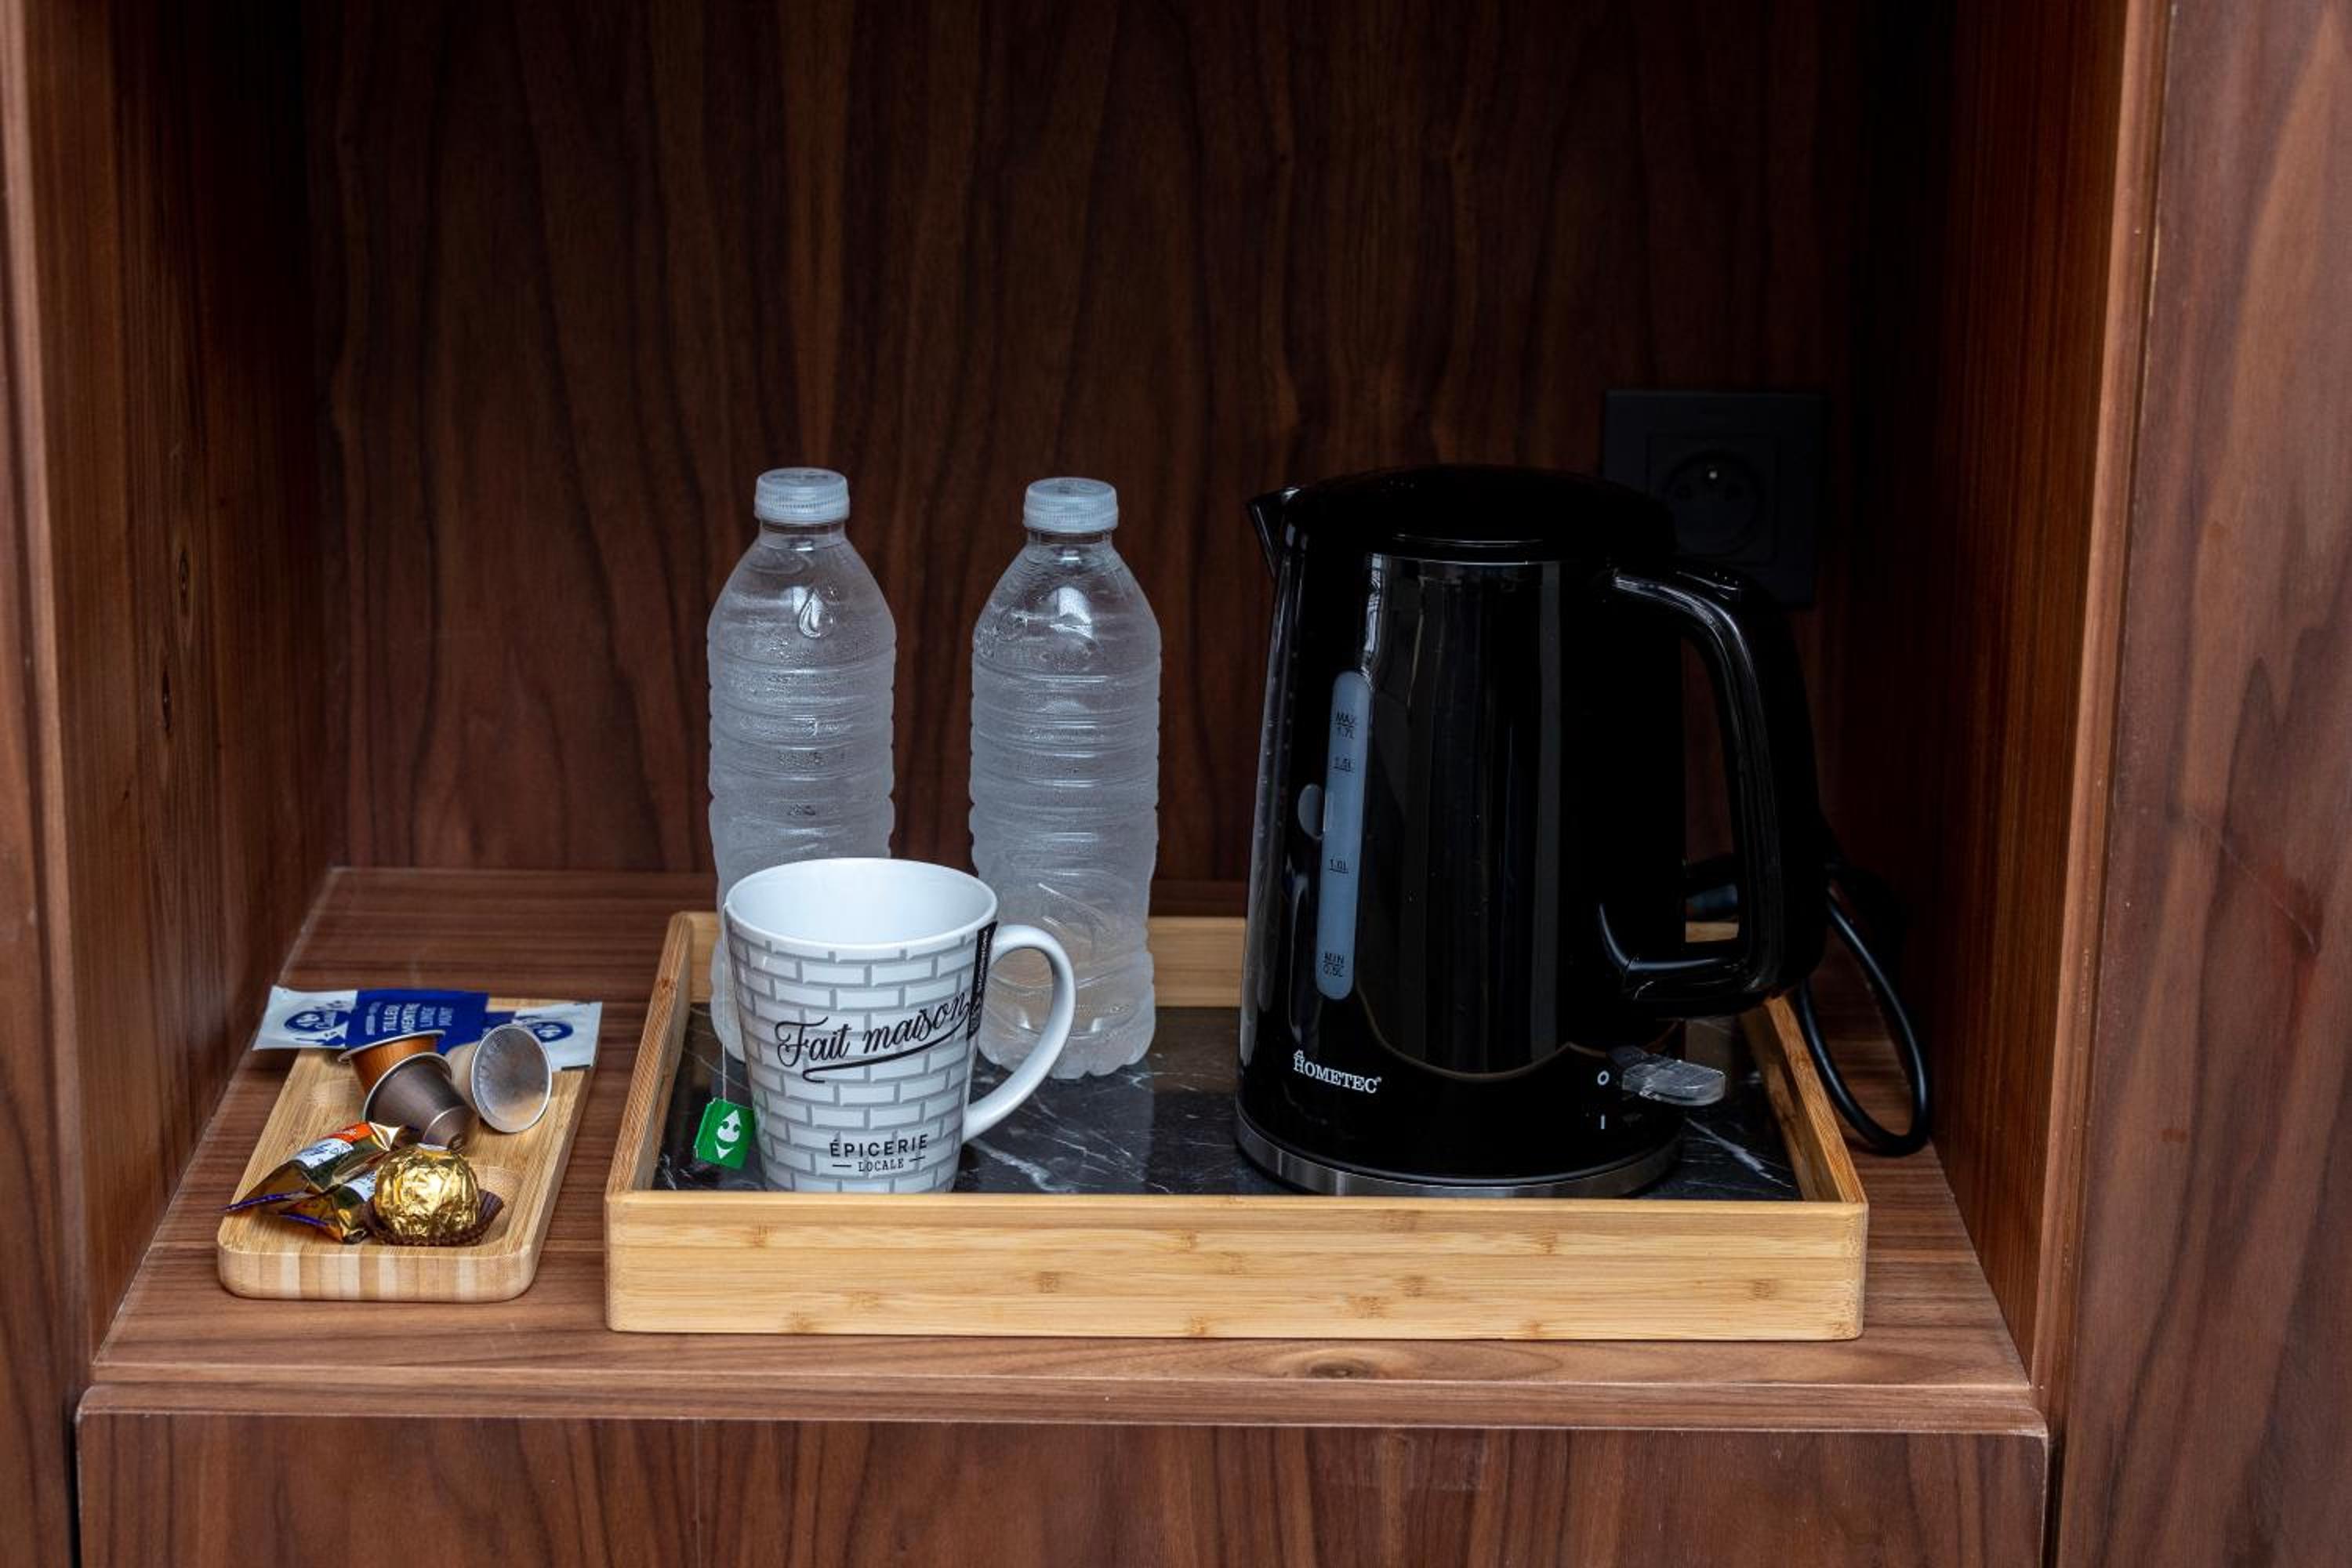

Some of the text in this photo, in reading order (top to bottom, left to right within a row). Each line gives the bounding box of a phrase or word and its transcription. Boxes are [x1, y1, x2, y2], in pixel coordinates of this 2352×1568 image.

[774, 1016, 851, 1067] Fait
[862, 991, 971, 1054] maison
[1293, 1055, 1377, 1094] HOMETEC
[829, 1134, 929, 1158] ÉPICERIE
[858, 1159, 905, 1173] LOCALE
